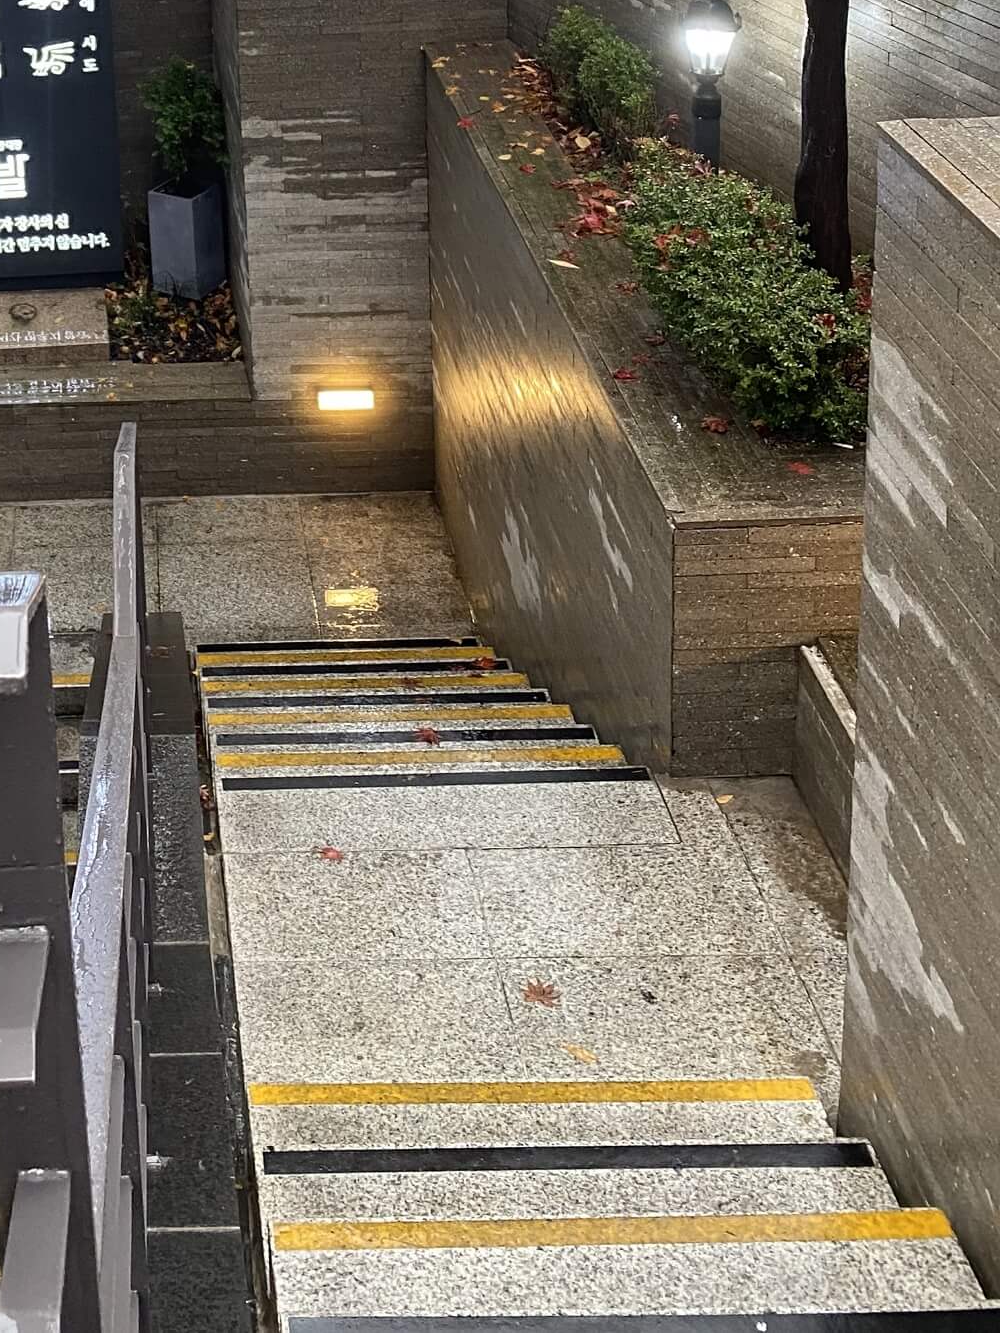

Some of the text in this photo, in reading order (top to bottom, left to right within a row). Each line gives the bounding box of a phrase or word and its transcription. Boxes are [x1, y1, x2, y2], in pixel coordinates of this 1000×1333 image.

[81, 34, 100, 73] 시도
[14, 212, 54, 233] 장사의
[16, 233, 56, 254] 멈추지
